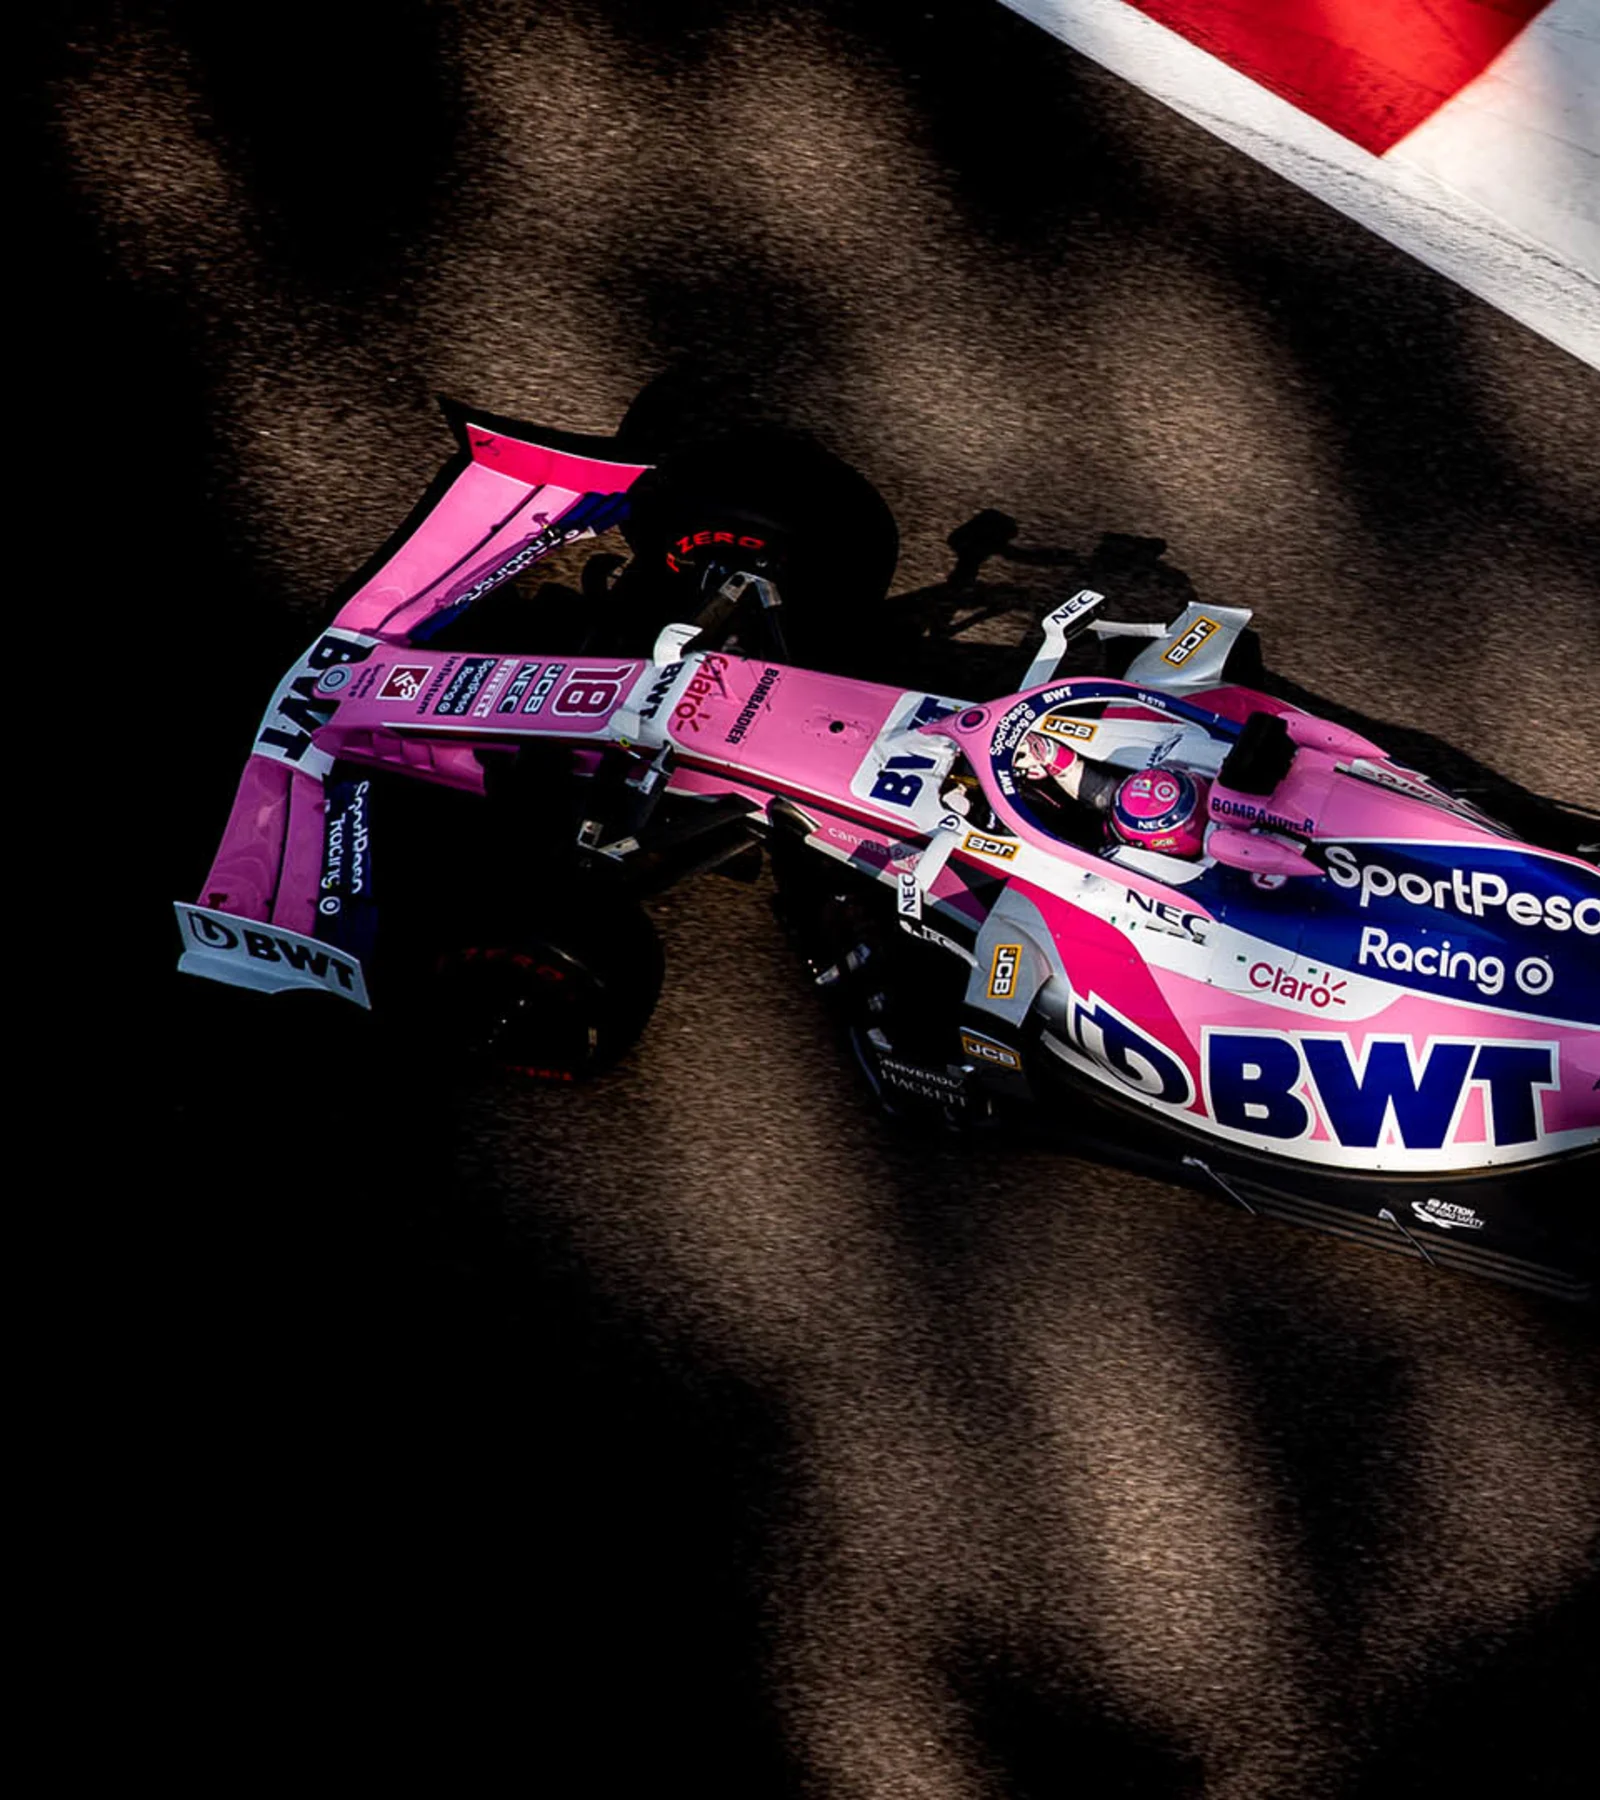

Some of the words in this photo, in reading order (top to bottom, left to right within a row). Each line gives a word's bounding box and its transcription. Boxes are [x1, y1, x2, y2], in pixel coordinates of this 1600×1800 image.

[676, 531, 766, 554] ZERO
[1051, 591, 1094, 625] NEC
[1167, 621, 1208, 663] JCB
[499, 663, 540, 714] NEC
[523, 663, 556, 714] JCB
[552, 663, 637, 717] 18
[639, 661, 686, 720] BWT
[675, 654, 729, 719] Claro
[725, 667, 779, 744] BOMBARDIER
[1042, 686, 1073, 705] BWT
[989, 702, 1029, 757] SportPesa
[1004, 718, 1029, 749] Racing
[1045, 720, 1093, 740] JCB
[997, 769, 1016, 796] BWT
[1130, 779, 1153, 799] 18
[1137, 818, 1169, 830] NEC
[968, 836, 1015, 860] JCB
[902, 873, 917, 913] NEC
[1126, 888, 1211, 940] NEC
[243, 929, 354, 990] BWT
[992, 947, 1016, 996] JCB
[1358, 926, 1506, 995] Racing
[1249, 962, 1331, 1008] Claro
[968, 1042, 1018, 1068] JCB
[1202, 1026, 1560, 1150] BWT
